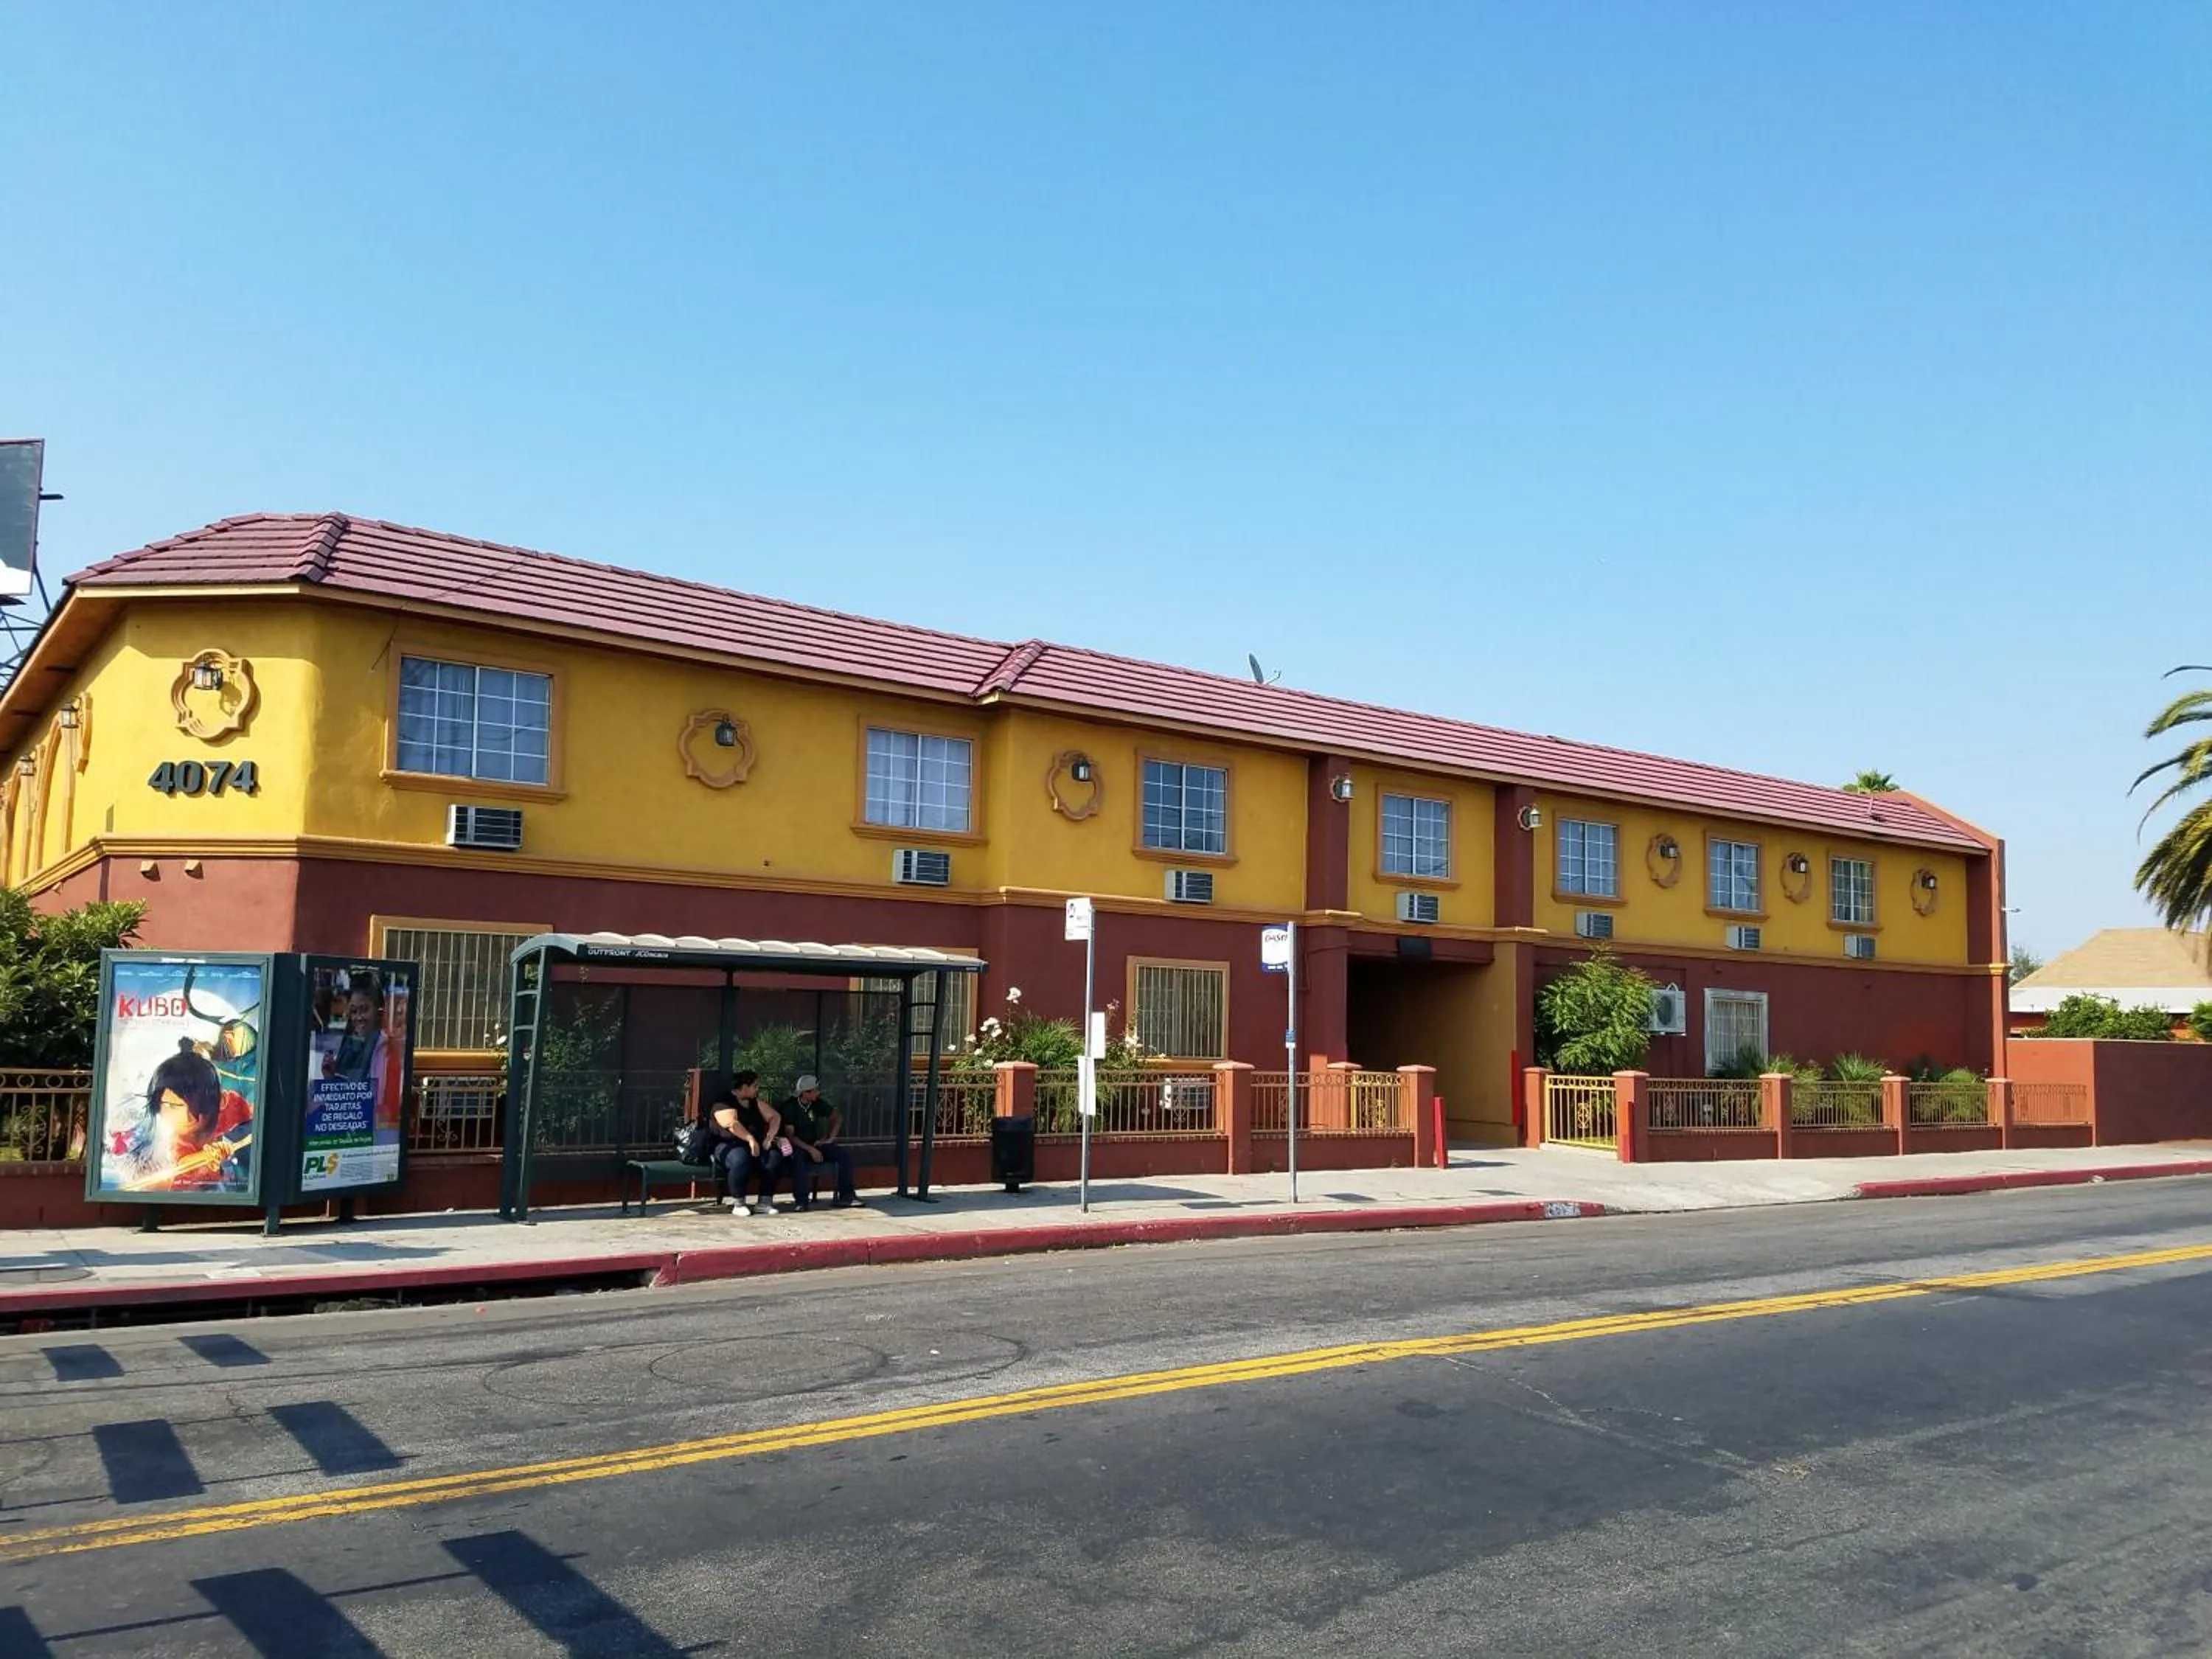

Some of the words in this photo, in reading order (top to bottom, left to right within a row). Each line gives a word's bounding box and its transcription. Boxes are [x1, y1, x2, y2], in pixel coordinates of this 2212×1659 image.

[147, 760, 257, 793] 4074
[588, 948, 631, 957] OUTFRONT
[118, 994, 188, 1018] KUBO
[321, 1082, 356, 1091] EFECTIVO
[358, 1082, 369, 1091] DE
[313, 1092, 355, 1102] INMEDIATO
[357, 1091, 372, 1099] POR
[324, 1102, 362, 1111] TARJETAS
[321, 1113, 333, 1121] DE
[333, 1111, 364, 1121] REGALO
[315, 1123, 327, 1132] NO
